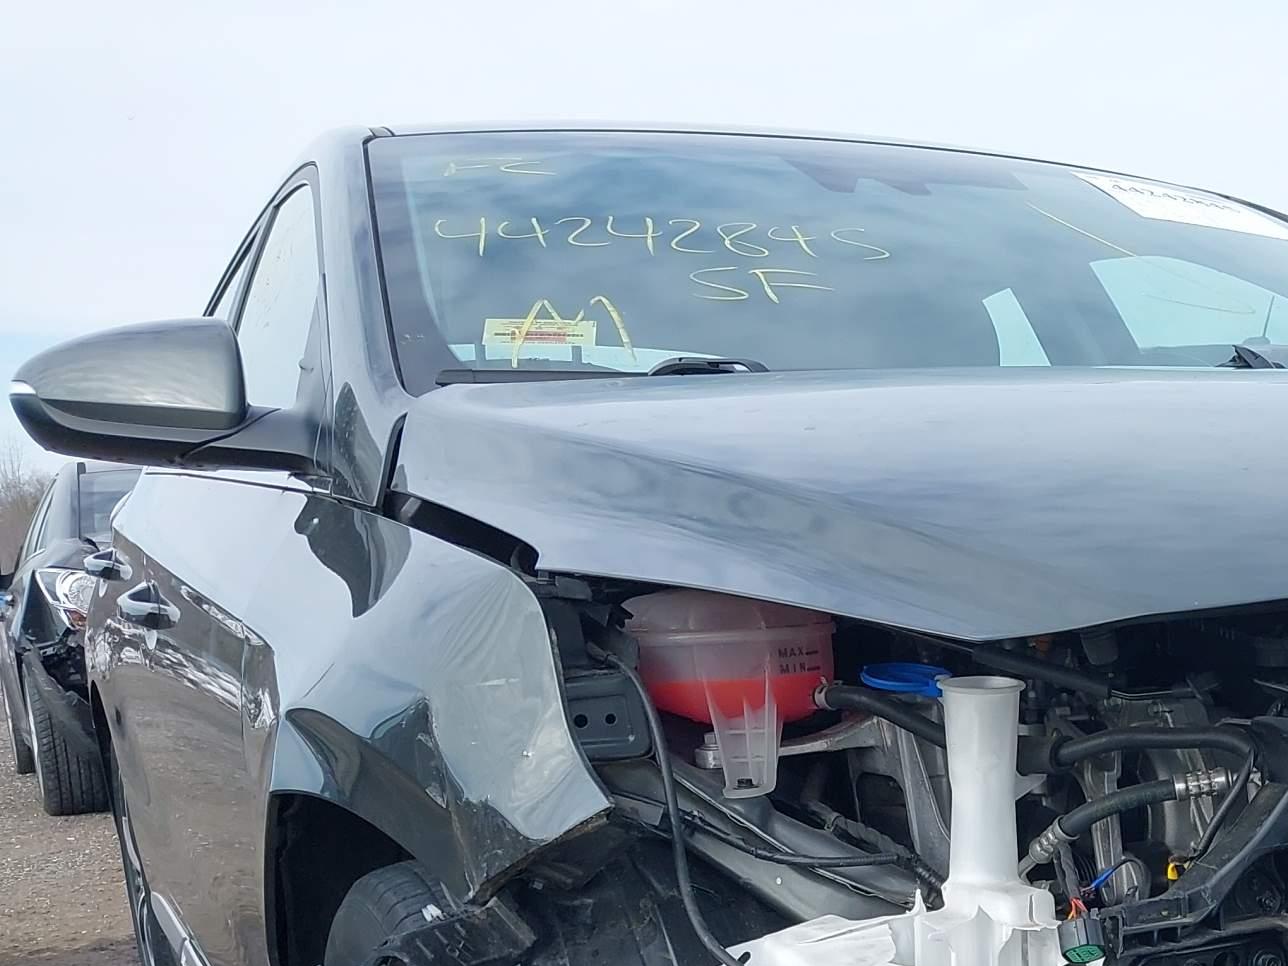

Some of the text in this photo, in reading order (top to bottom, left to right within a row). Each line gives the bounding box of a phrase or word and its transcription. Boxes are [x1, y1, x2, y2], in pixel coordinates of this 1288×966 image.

[690, 266, 833, 303] SF
[778, 646, 804, 658] MAX
[779, 662, 806, 674] MIN
